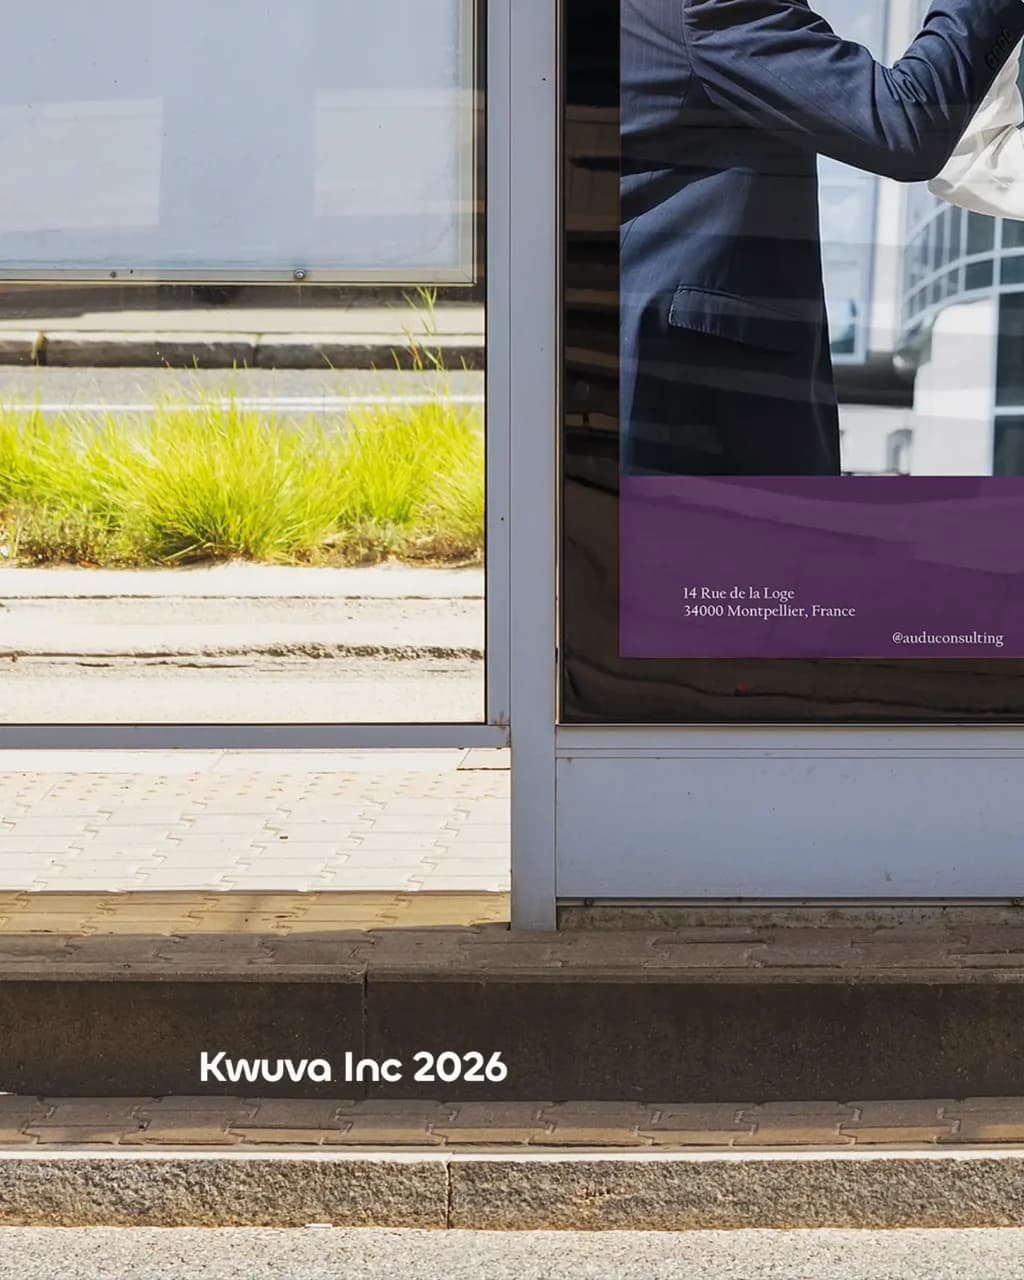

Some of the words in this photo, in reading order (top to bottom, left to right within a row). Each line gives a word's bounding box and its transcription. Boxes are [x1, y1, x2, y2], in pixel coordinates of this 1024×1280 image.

[684, 587, 697, 599] 14
[700, 587, 727, 599] Rue
[729, 586, 746, 599] de
[749, 586, 761, 599] la
[763, 587, 796, 603] Loge
[684, 604, 724, 617] 34000
[727, 604, 809, 621] Montpellier,
[812, 604, 856, 617] France
[892, 631, 1004, 648] @auduconsulting
